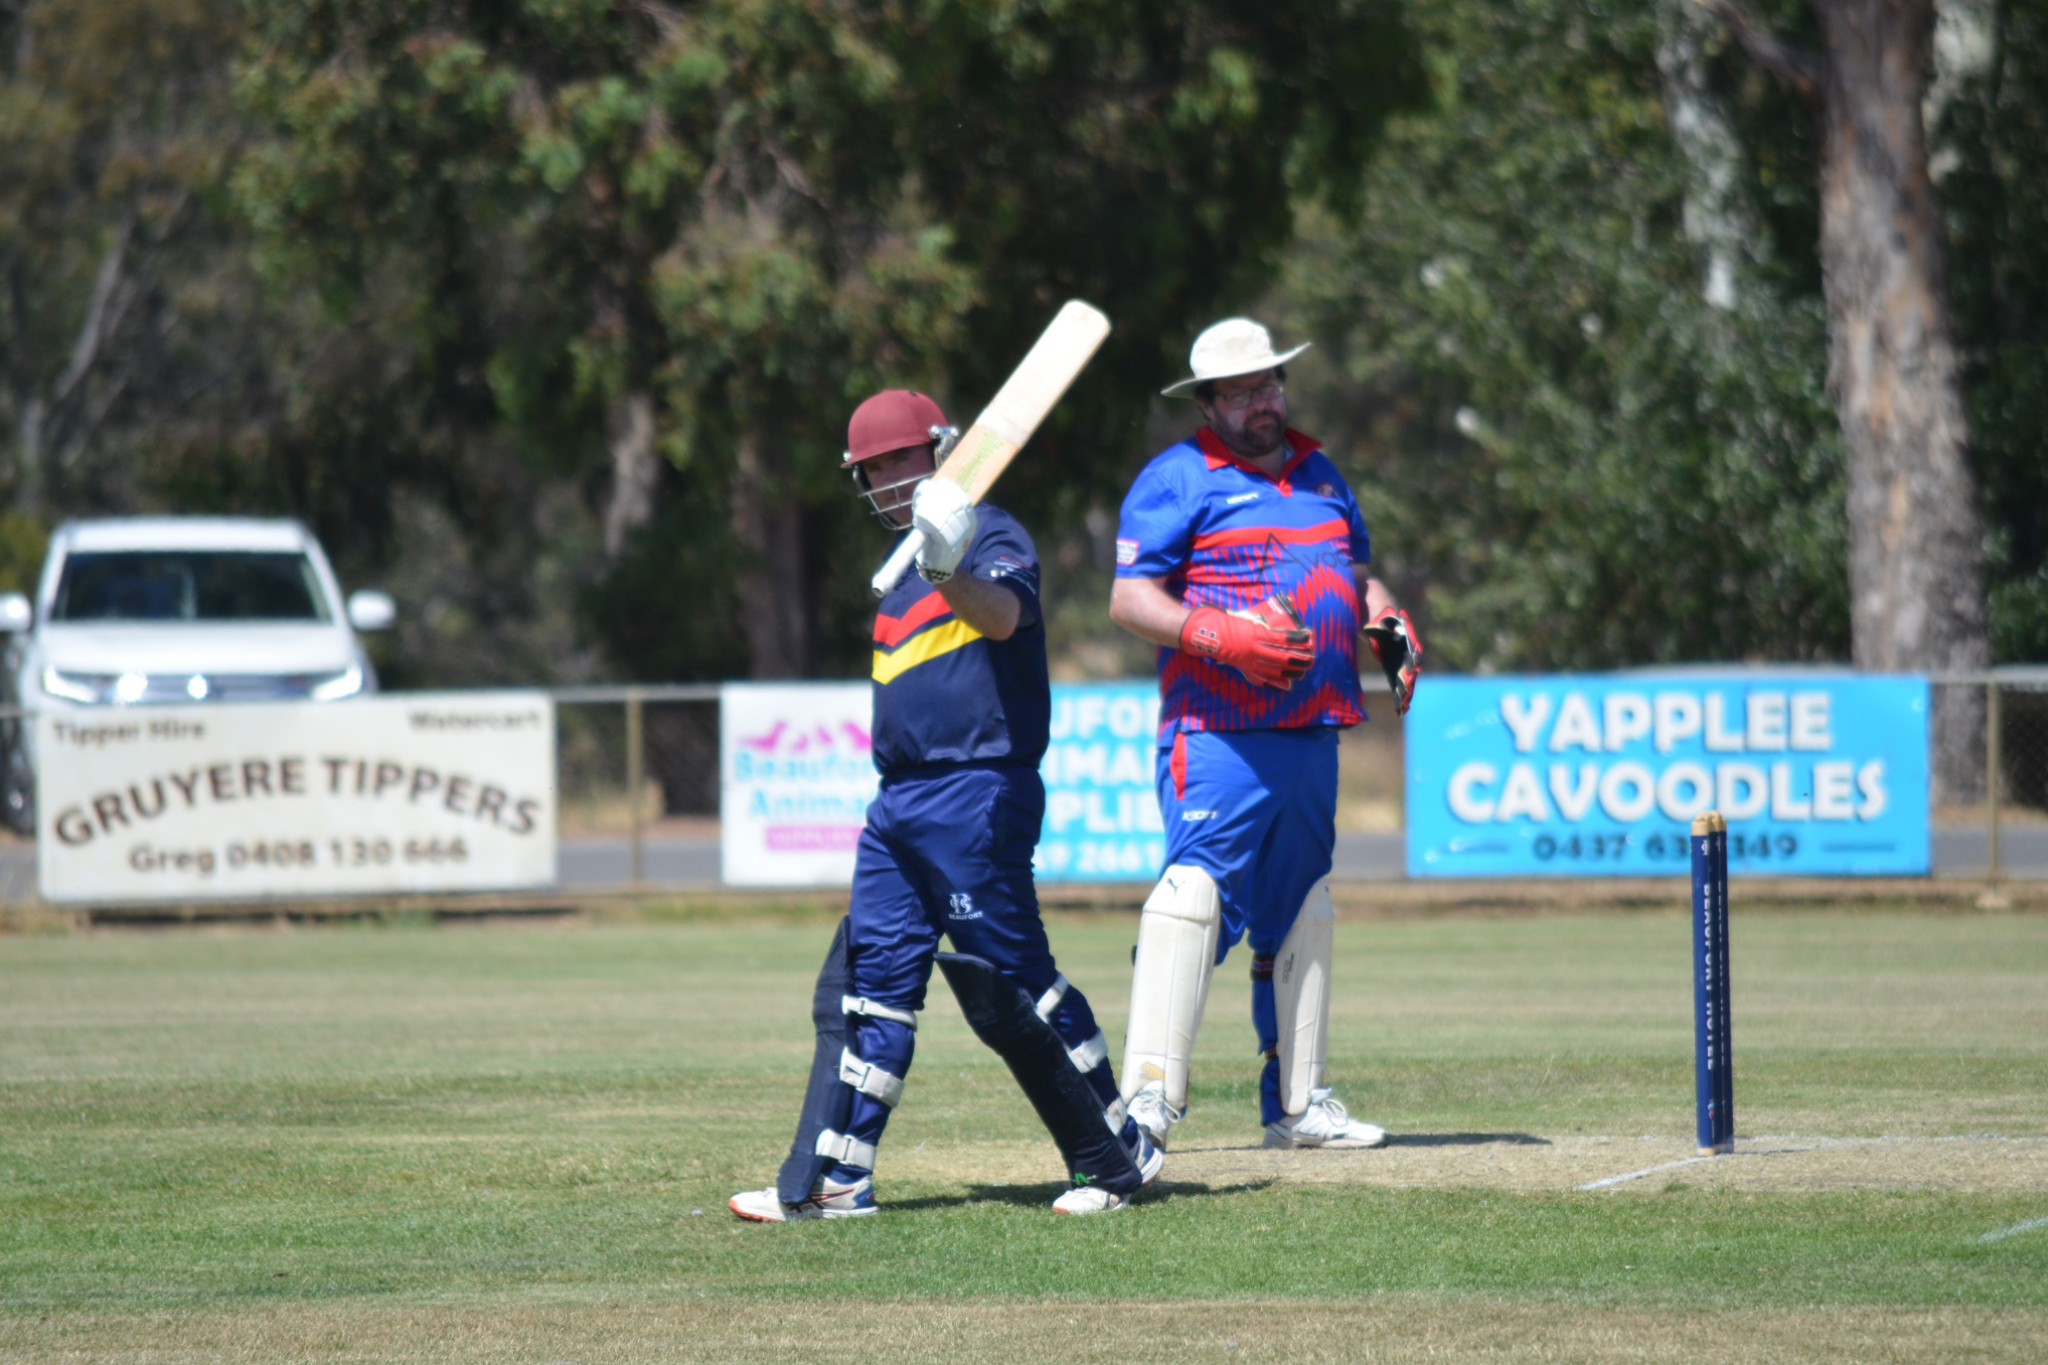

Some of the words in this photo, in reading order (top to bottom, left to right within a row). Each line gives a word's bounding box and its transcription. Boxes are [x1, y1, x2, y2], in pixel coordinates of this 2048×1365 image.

[52, 717, 140, 746] Tipper
[147, 716, 206, 739] Hire
[1500, 691, 1833, 753] YAPPLEE
[54, 757, 307, 848] GRUYERE
[321, 755, 540, 836] TIPPERS
[747, 789, 869, 818] Anima
[1447, 760, 1887, 823] CAVOODLES
[129, 845, 214, 875] Greg
[226, 838, 316, 870] 0408
[330, 839, 393, 866] 130
[404, 836, 469, 864] 666
[1532, 833, 1628, 862] 0437
[1644, 834, 1692, 862] 63
